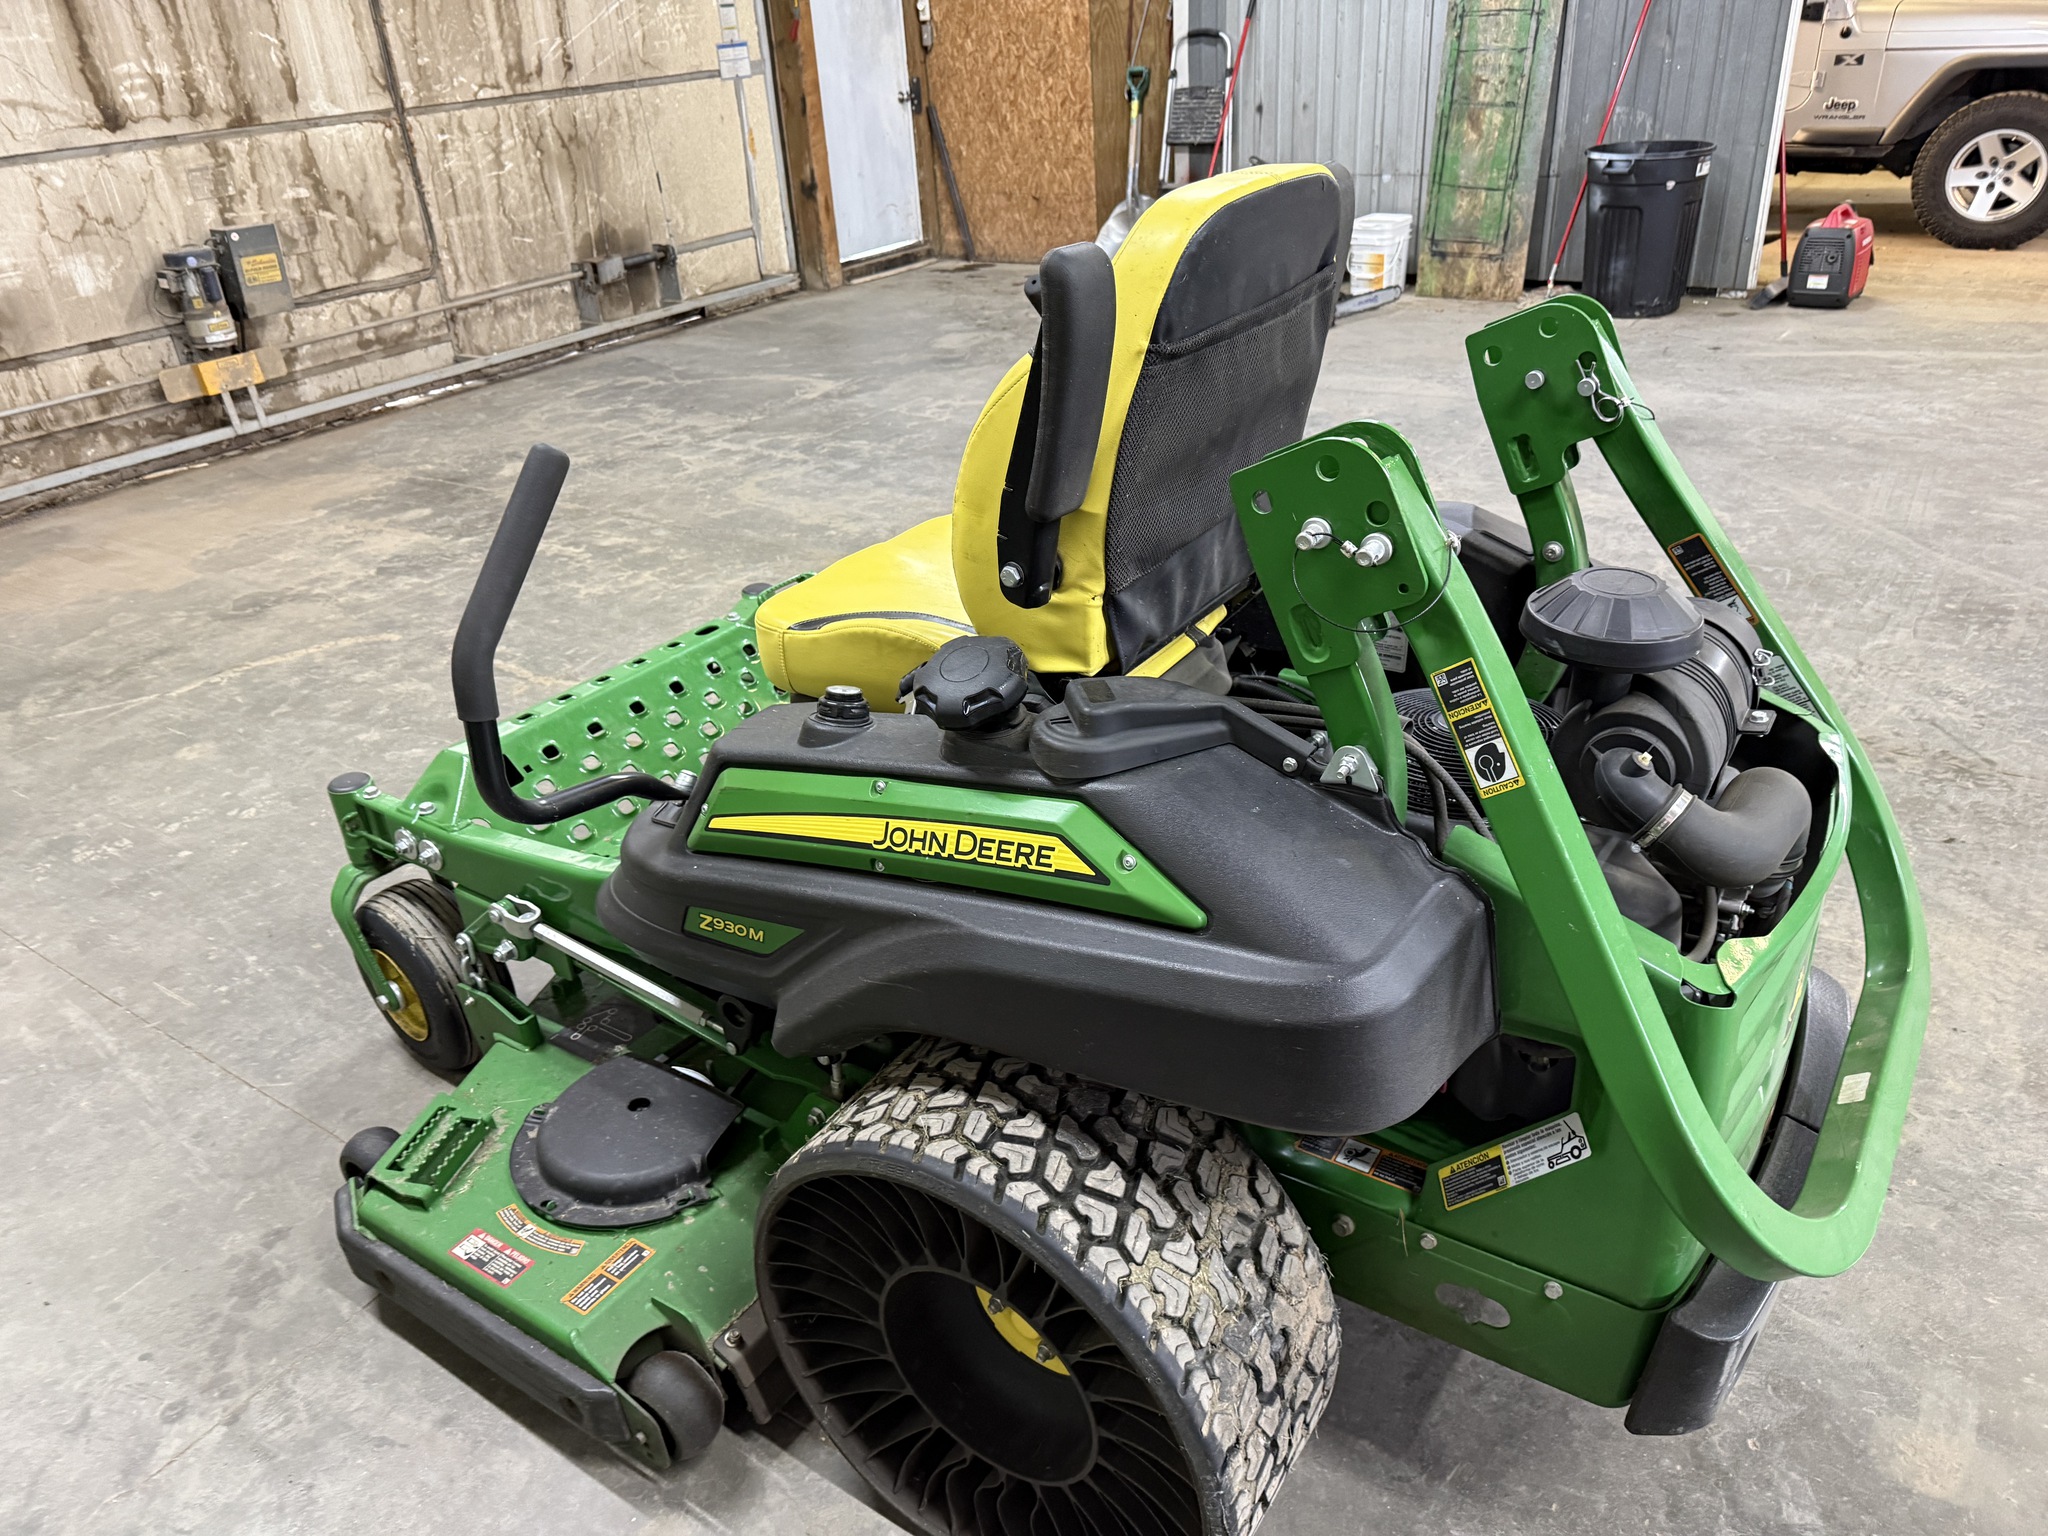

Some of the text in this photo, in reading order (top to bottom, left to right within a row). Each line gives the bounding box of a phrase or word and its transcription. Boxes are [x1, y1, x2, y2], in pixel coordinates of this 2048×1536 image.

[1823, 97, 1859, 113] Jeep
[1448, 702, 1482, 719] ATENCIÓN
[1482, 781, 1513, 795] CAUTION
[873, 821, 1056, 869] JOHN DEERE
[1456, 1151, 1489, 1171] ATENCIÓN
